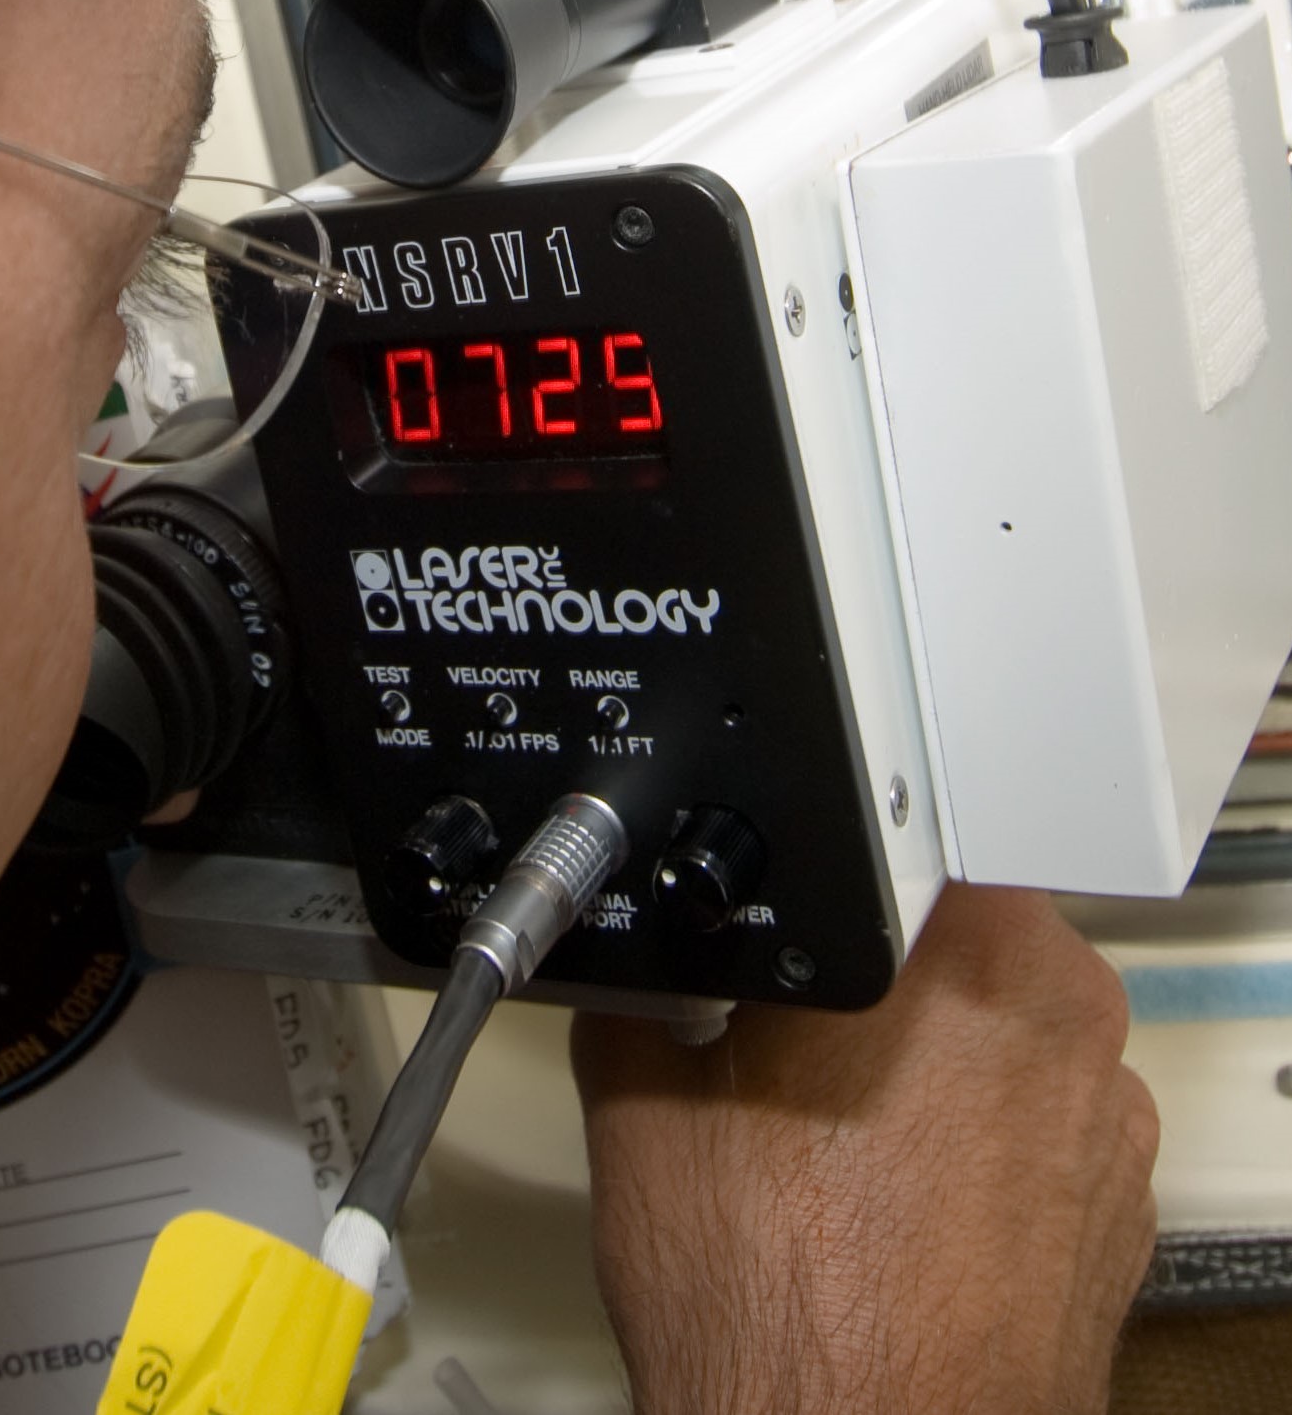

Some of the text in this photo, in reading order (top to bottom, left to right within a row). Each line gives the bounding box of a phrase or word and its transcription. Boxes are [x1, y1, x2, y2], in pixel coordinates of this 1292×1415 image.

[385, 333, 663, 442] 0725
[393, 546, 544, 588] LASER
[404, 588, 721, 633] TECHNOLOGY
[362, 665, 412, 684] TEST
[446, 666, 541, 687] VELOCITY
[568, 669, 641, 689] RANGE
[375, 727, 432, 747] MODE
[582, 911, 633, 931] PORT
[45, 953, 126, 1038] KOPRA
